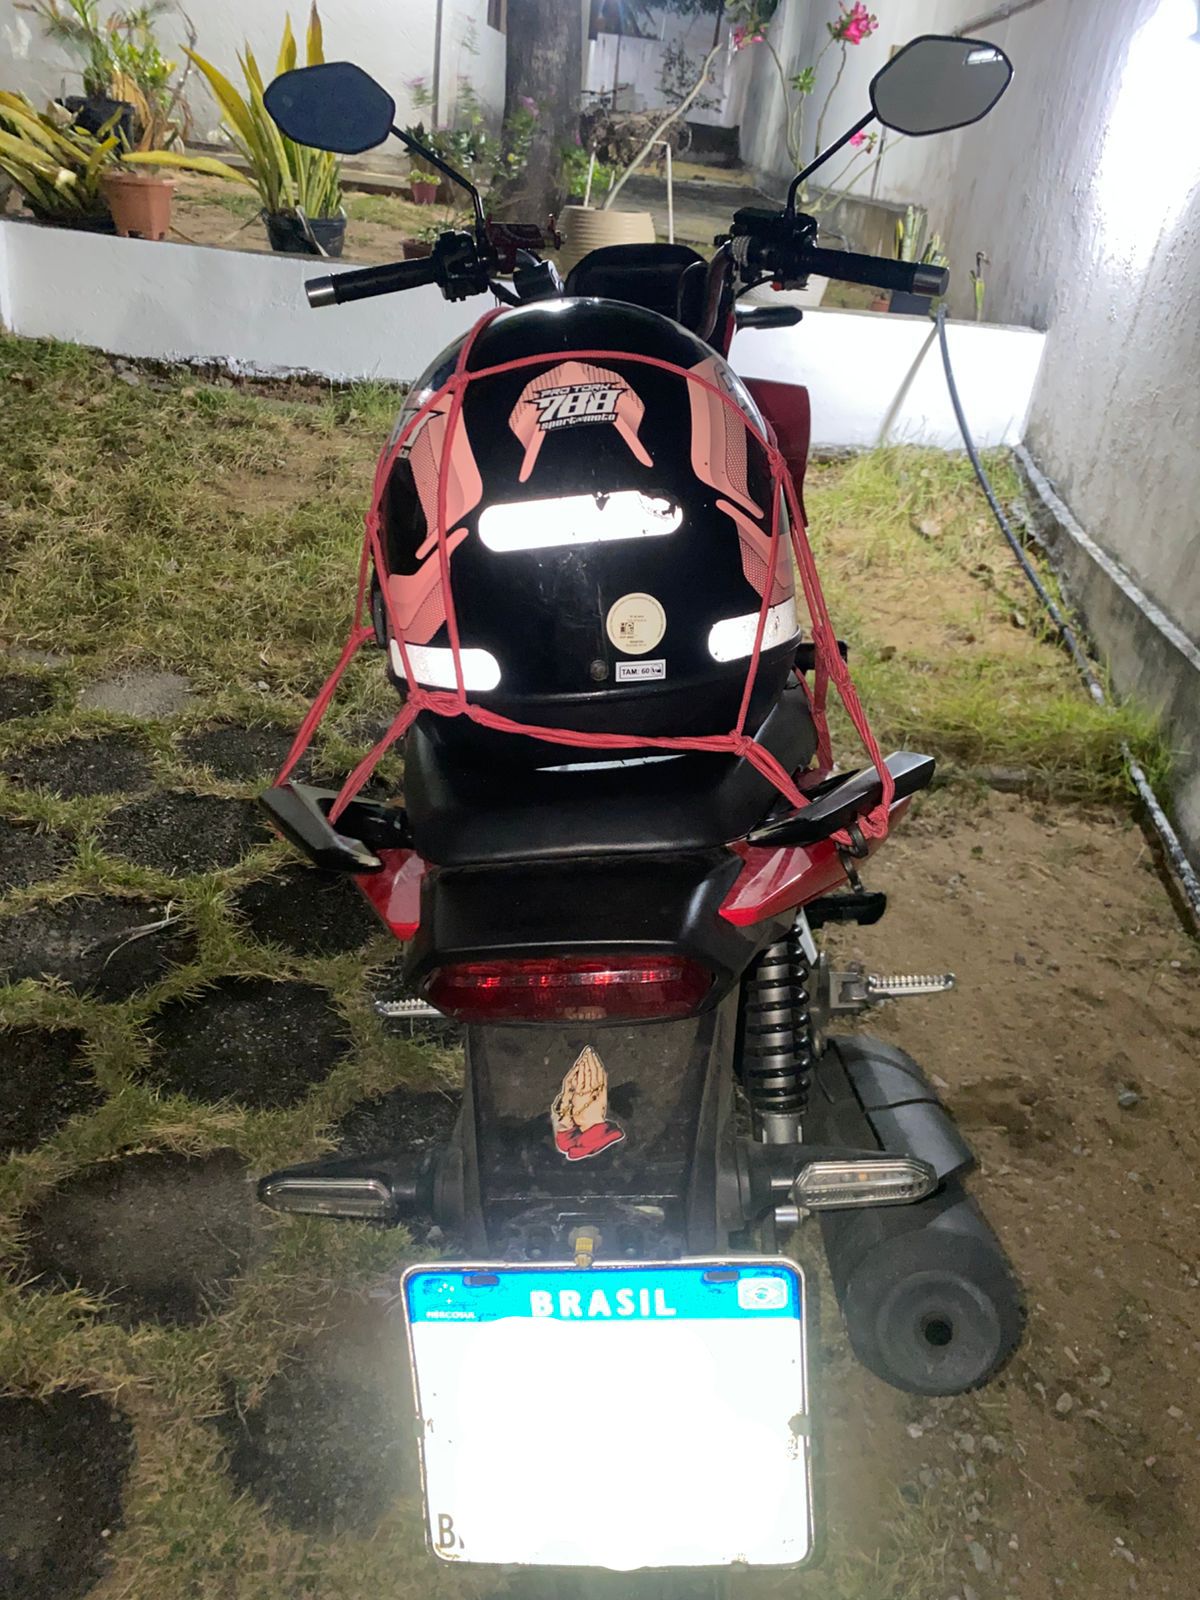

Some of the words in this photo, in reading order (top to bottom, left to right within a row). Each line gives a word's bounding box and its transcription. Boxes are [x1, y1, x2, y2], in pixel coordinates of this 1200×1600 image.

[541, 387, 570, 398] PRO
[573, 383, 611, 394] TORK
[532, 390, 624, 422] 788
[541, 415, 576, 430] sport
[583, 413, 616, 423] moto
[530, 1288, 677, 1317] BRASIL
